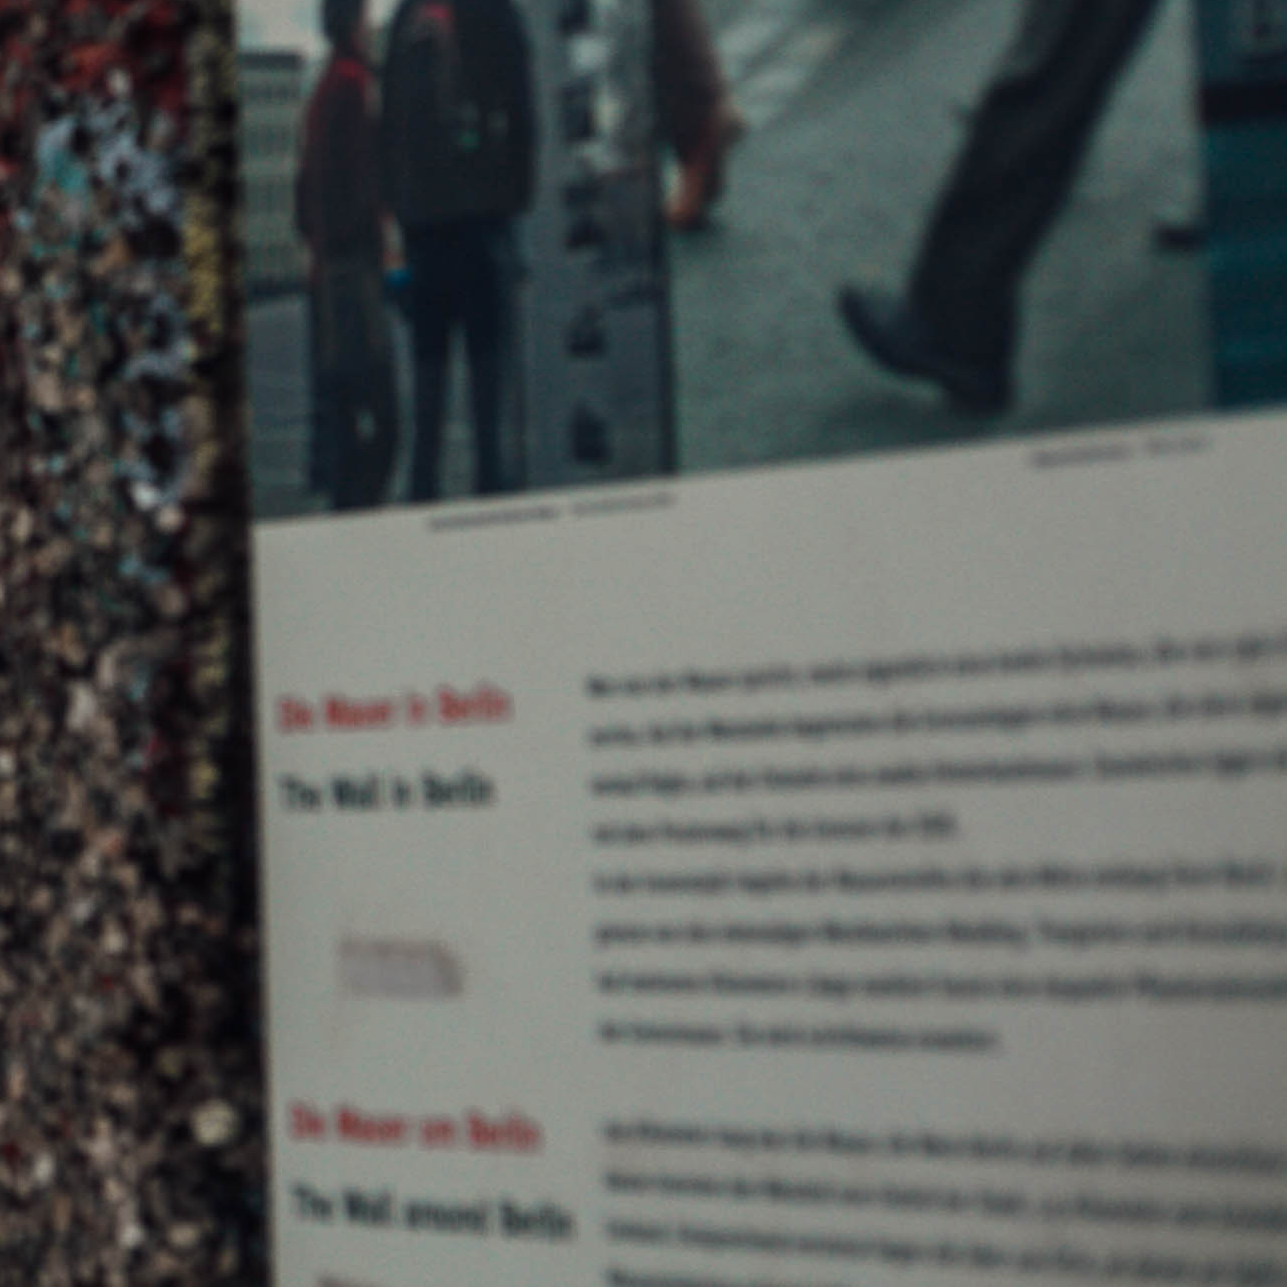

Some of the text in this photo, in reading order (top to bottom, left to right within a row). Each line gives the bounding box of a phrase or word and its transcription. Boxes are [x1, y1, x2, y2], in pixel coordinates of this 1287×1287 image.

[436, 682, 512, 724] Berlin
[421, 768, 497, 807] Berlin
[467, 1110, 543, 1155] Berlin
[498, 1194, 575, 1244] Berlin
